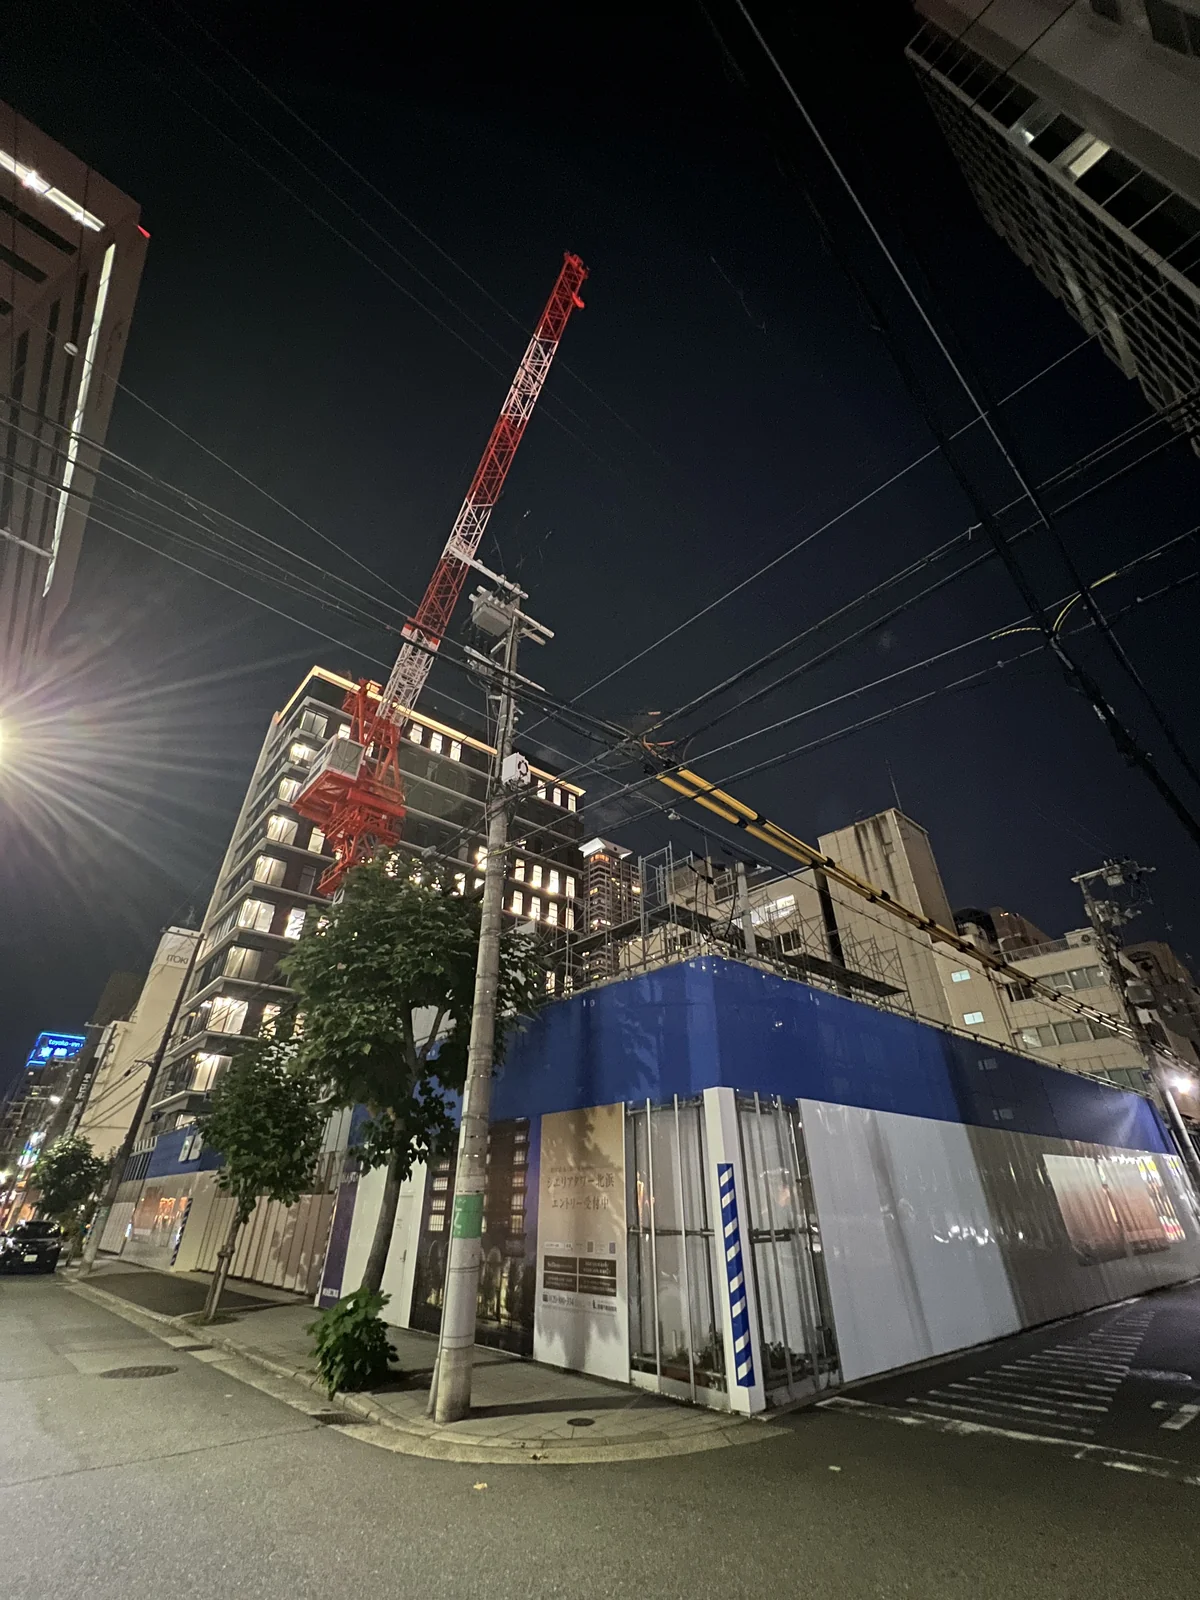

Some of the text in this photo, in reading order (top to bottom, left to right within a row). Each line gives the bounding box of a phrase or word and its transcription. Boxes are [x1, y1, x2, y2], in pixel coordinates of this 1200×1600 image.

[166, 954, 189, 965] ITOKI
[547, 1172, 615, 1189] シエリアタワー北浜
[551, 1195, 609, 1210] エントリー受付中
